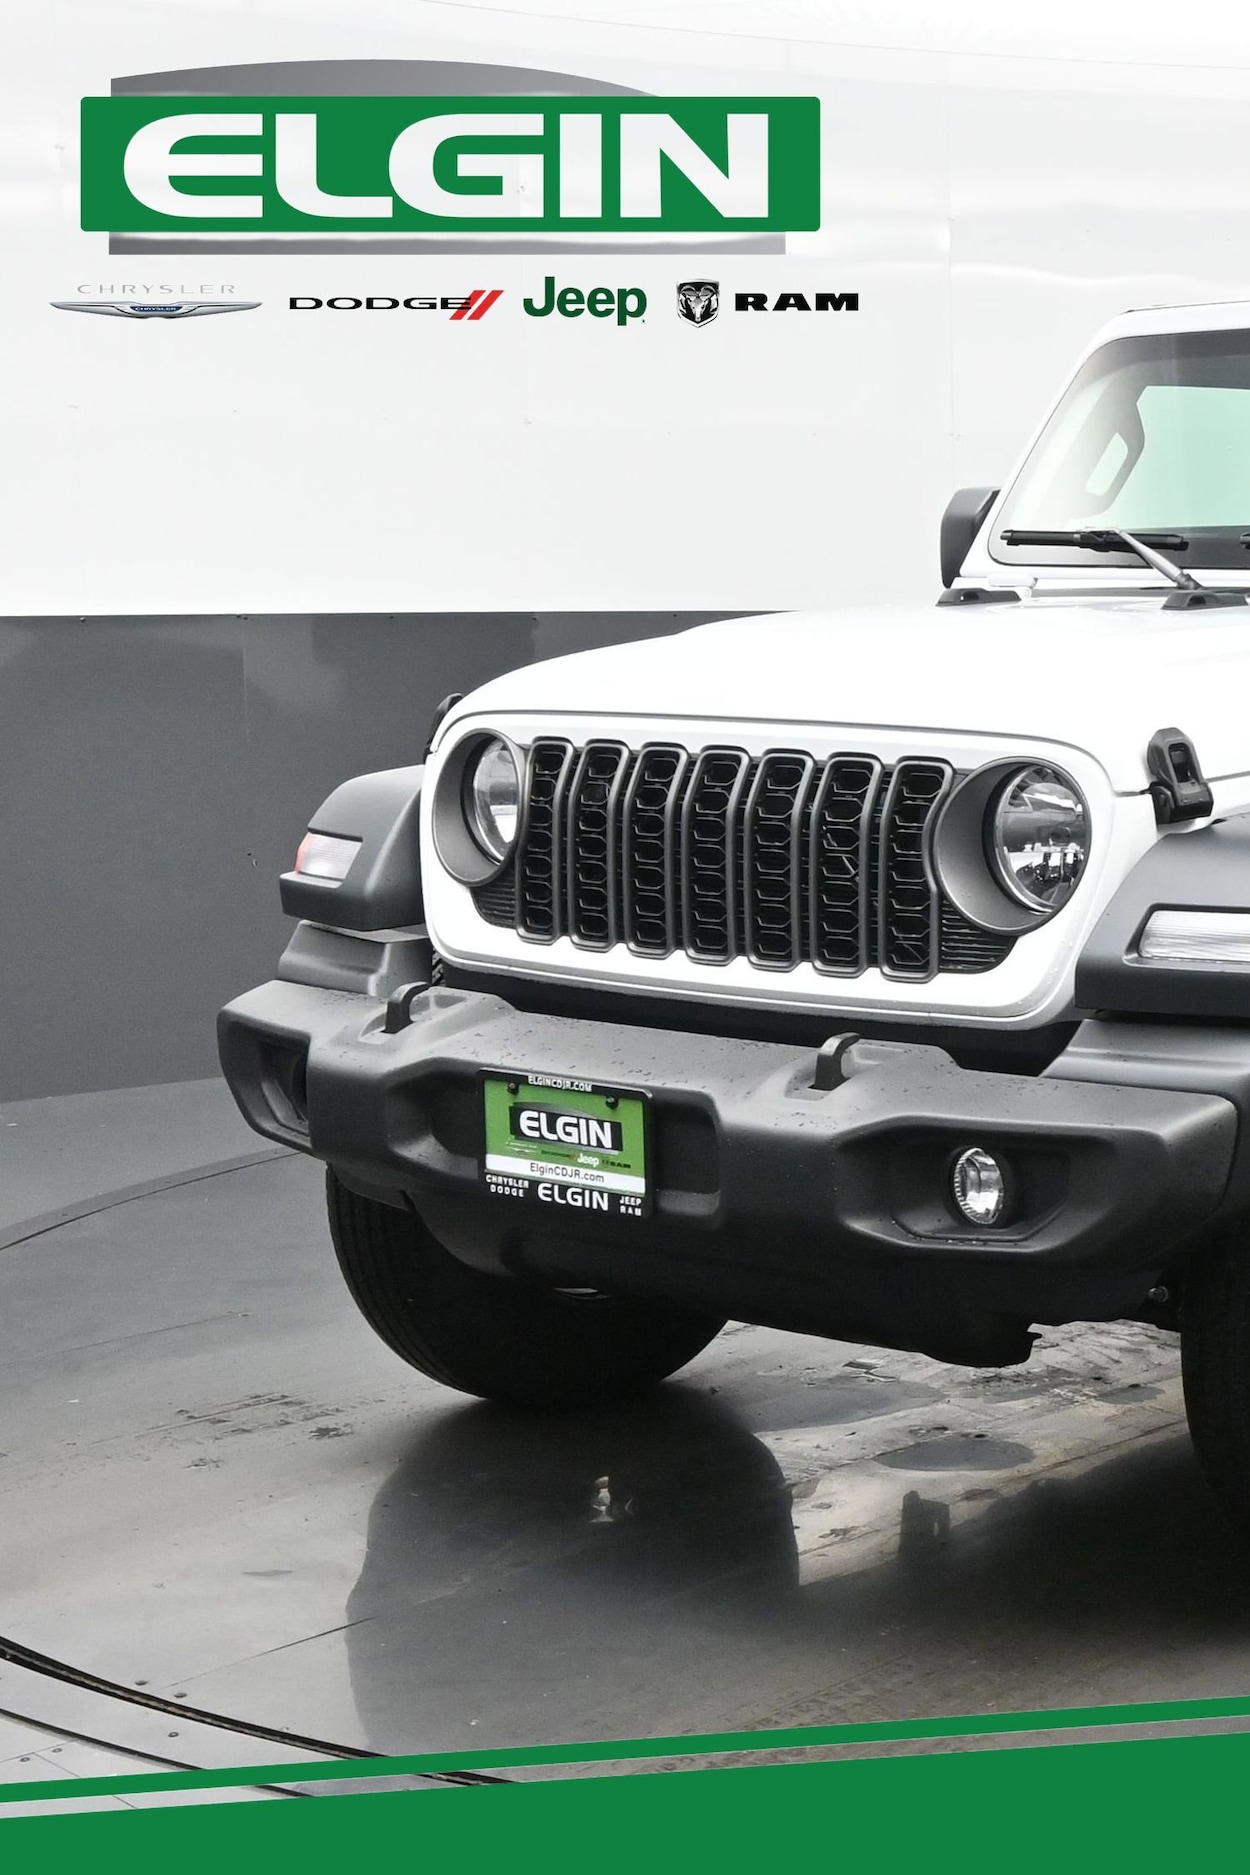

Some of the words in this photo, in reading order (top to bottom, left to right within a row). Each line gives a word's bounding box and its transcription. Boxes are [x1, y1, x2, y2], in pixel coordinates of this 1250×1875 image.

[528, 1075, 593, 1093] ELGINCDJR.COM
[519, 1109, 613, 1149] ELGIN
[577, 1152, 600, 1168] Jeep
[530, 1162, 605, 1183] ElginCDJR.com
[486, 1174, 530, 1189] CHRYSLER
[490, 1184, 525, 1198] DODGE
[537, 1182, 609, 1212] ELGIN
[619, 1196, 642, 1206] JEEP
[619, 1205, 642, 1217] RAM
